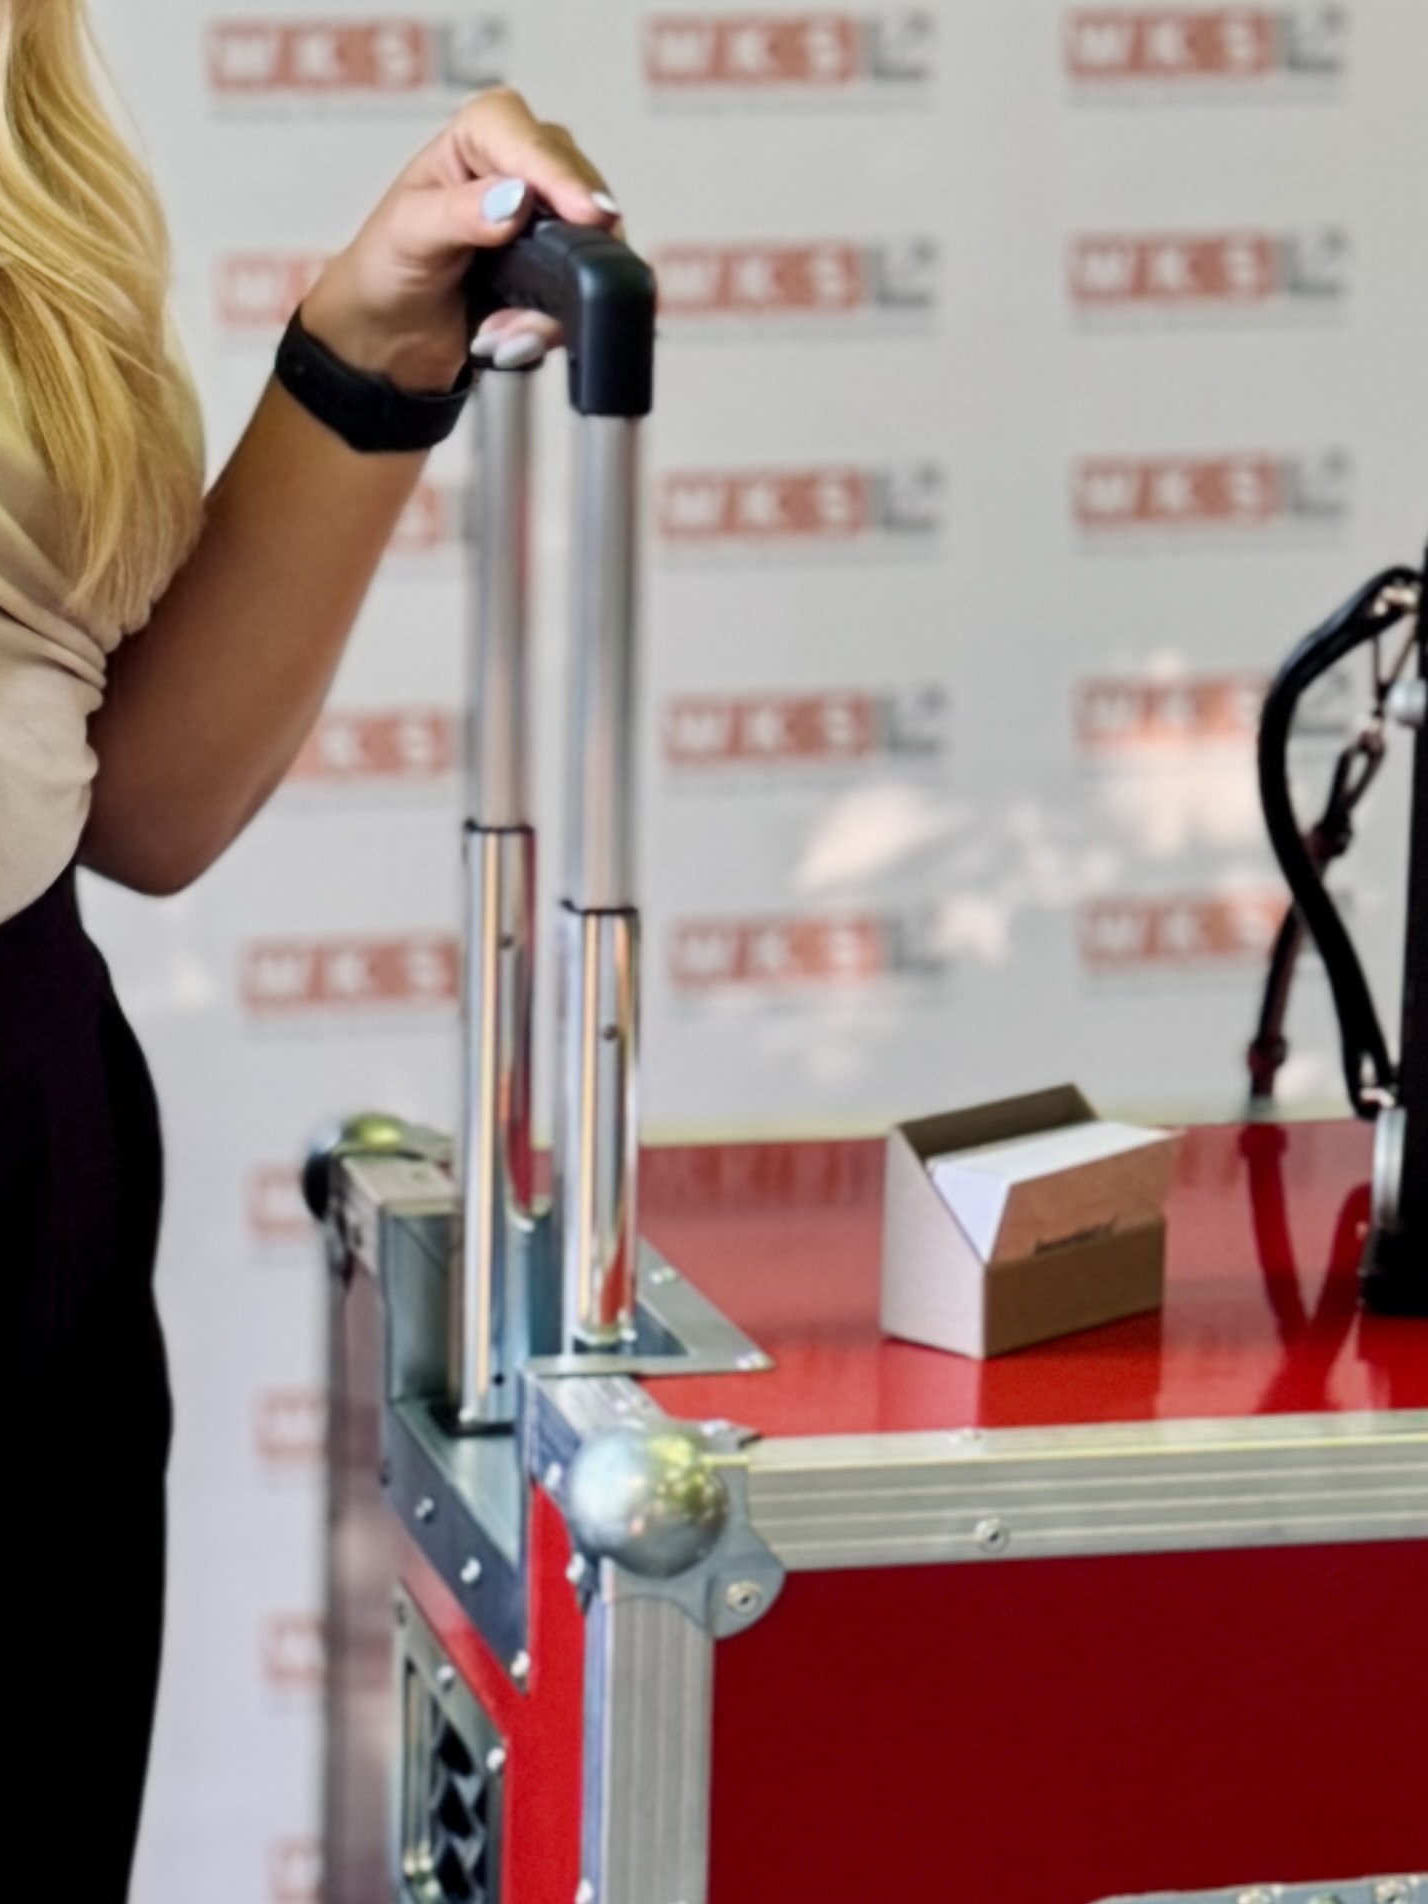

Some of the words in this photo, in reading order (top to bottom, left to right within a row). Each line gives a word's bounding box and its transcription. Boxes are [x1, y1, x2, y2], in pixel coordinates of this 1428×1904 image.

[213, 30, 419, 83] WKS
[649, 24, 849, 78] WKS
[1070, 18, 1263, 71] WKS
